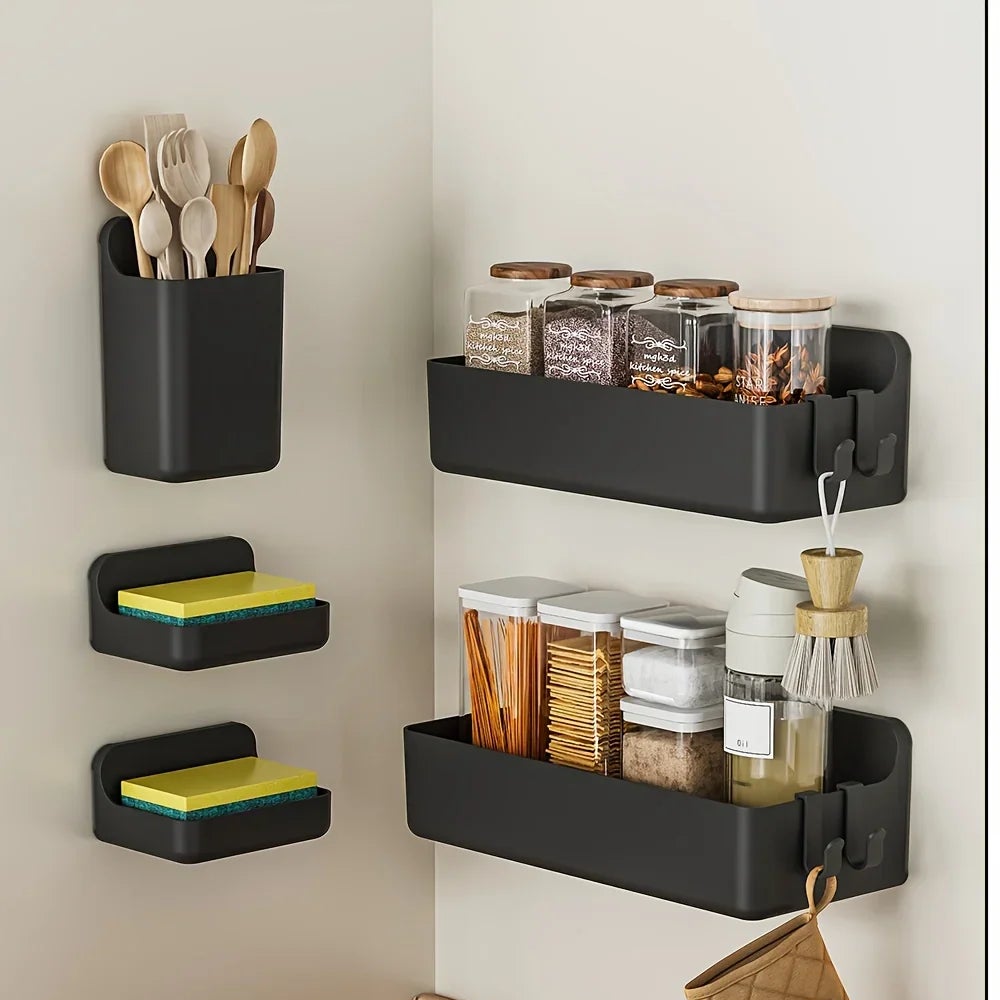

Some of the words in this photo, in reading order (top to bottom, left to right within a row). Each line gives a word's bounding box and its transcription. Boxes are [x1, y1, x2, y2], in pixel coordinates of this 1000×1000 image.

[630, 361, 663, 373] kitchen
[668, 367, 691, 377] spice
[736, 375, 763, 390] STAR
[736, 739, 749, 748] Oil
